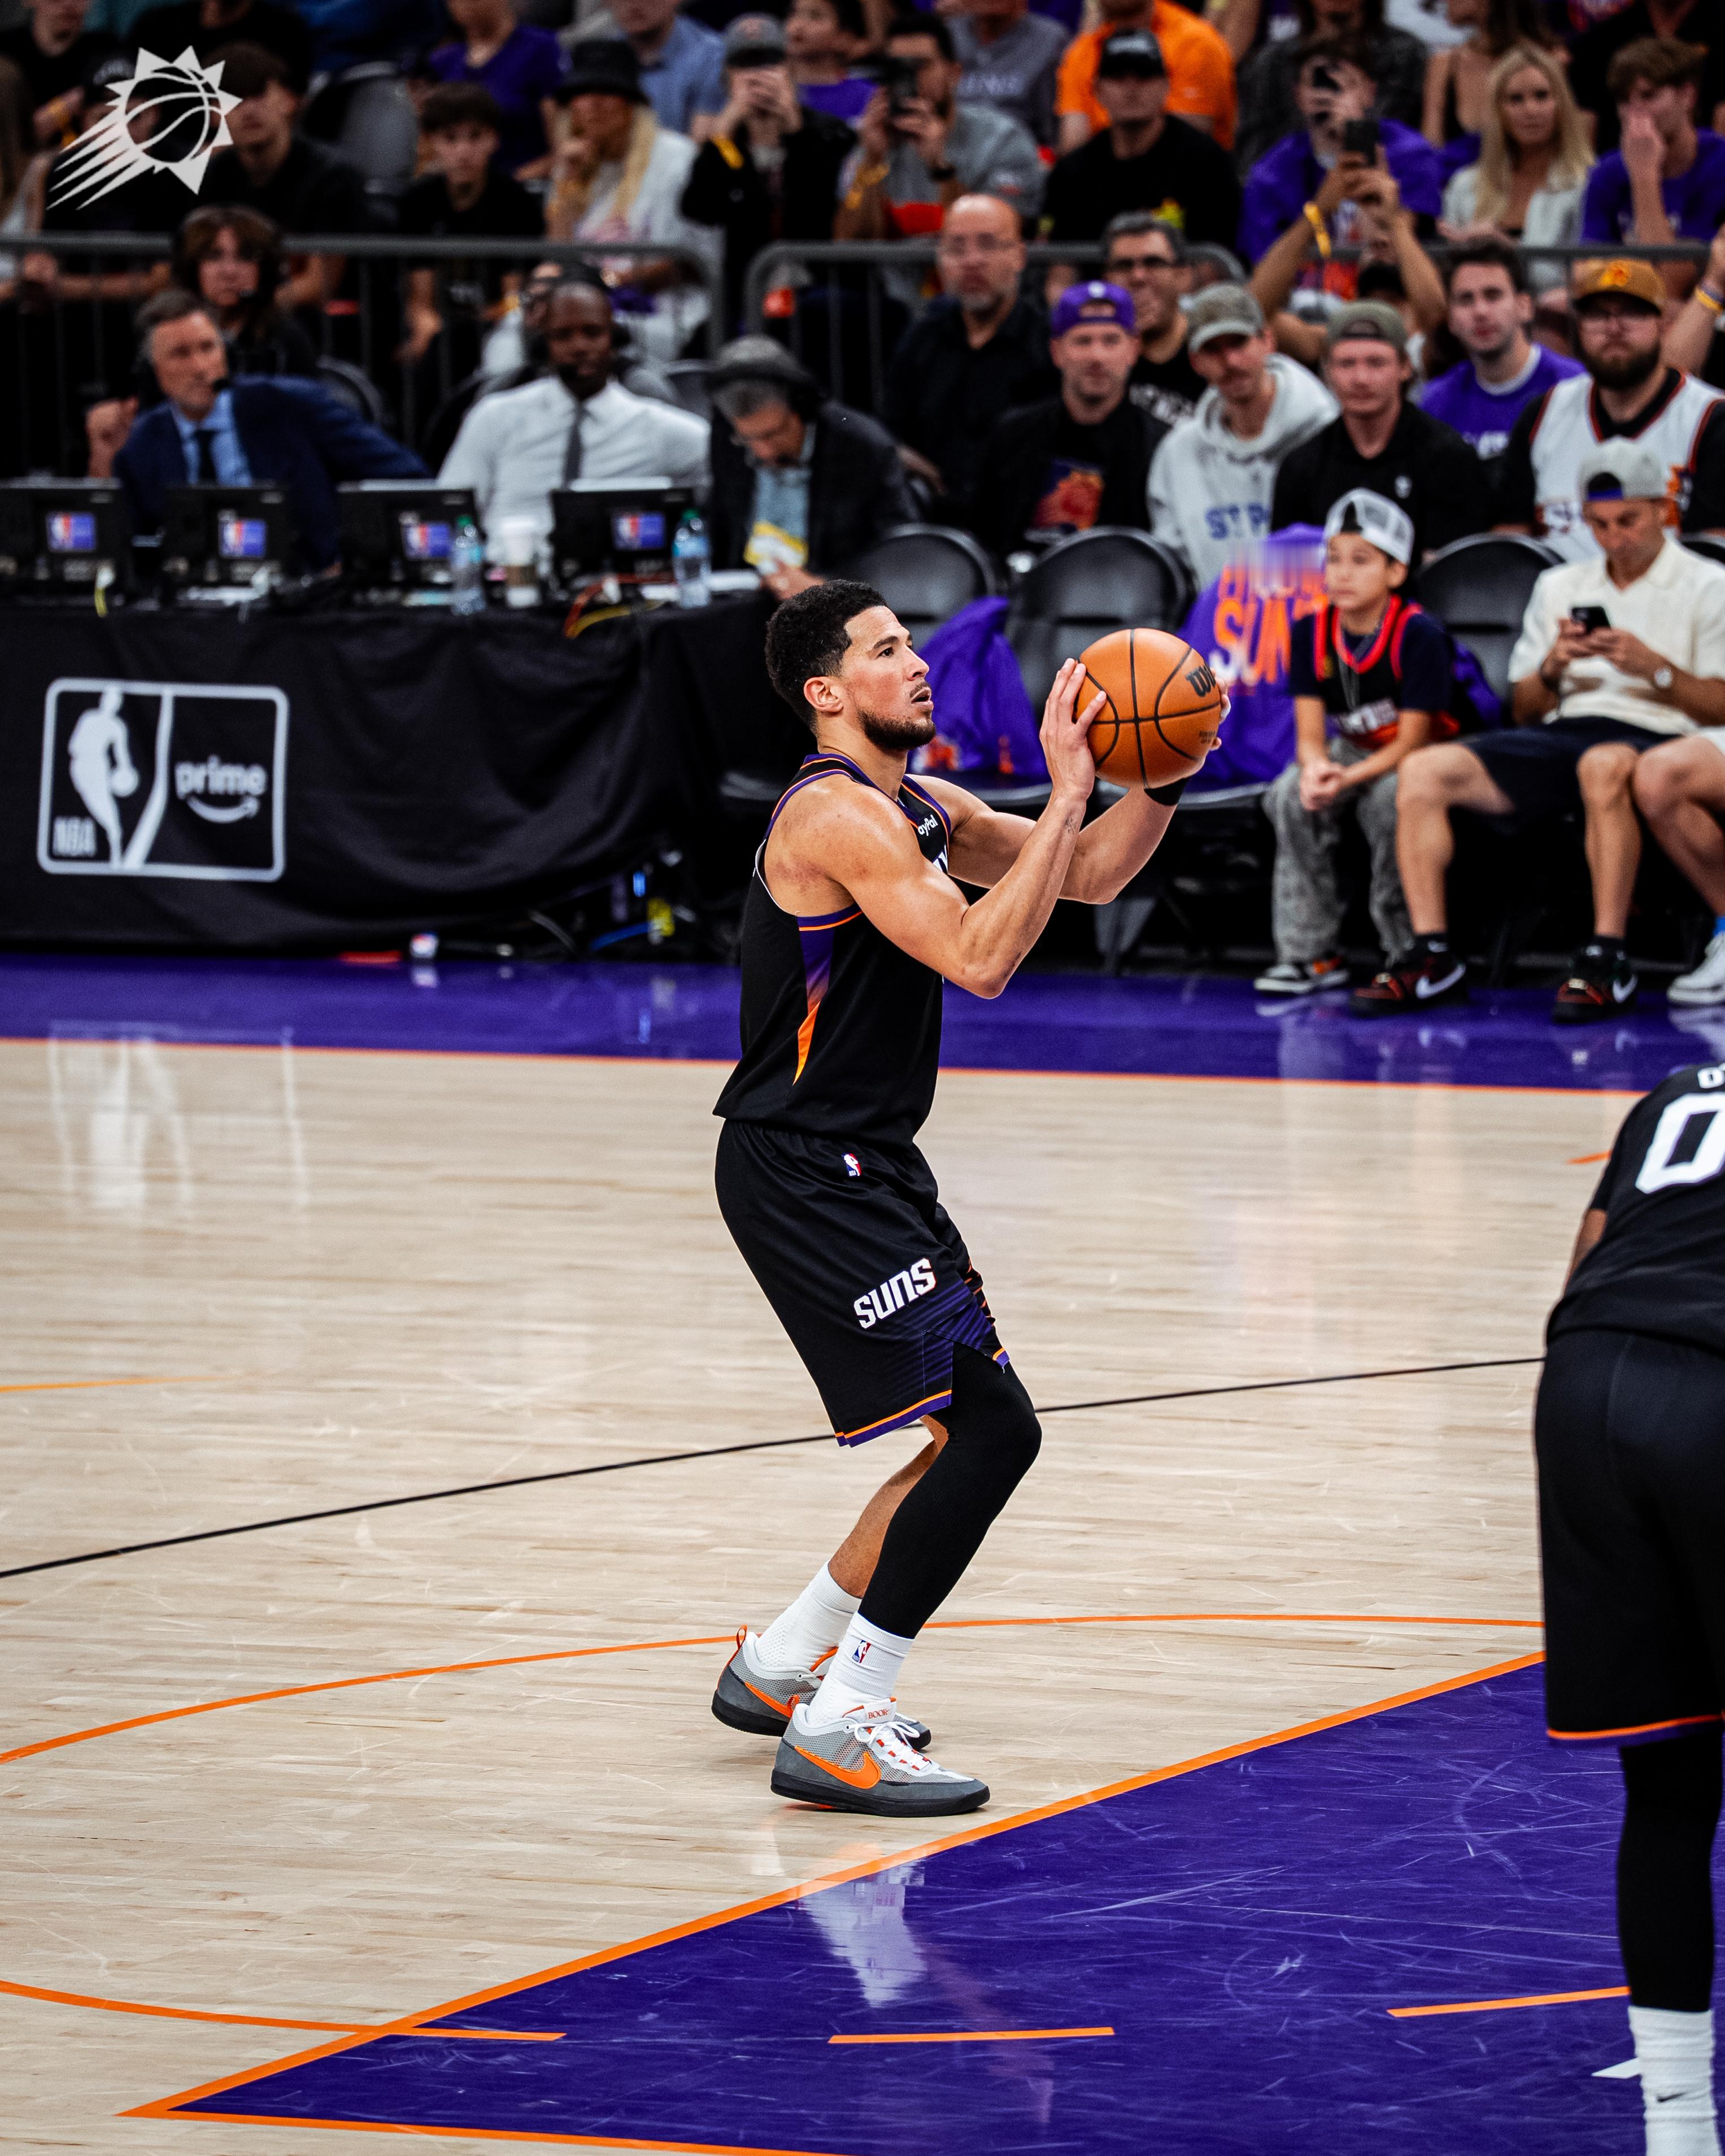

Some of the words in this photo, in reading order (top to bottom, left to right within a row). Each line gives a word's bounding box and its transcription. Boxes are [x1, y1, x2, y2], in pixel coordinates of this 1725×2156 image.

[175, 754, 267, 800] prime
[53, 816, 97, 857] NBA
[918, 814, 938, 836] ayPal
[853, 1257, 936, 1329] SUNS
[868, 1709, 889, 1719] BOOK
